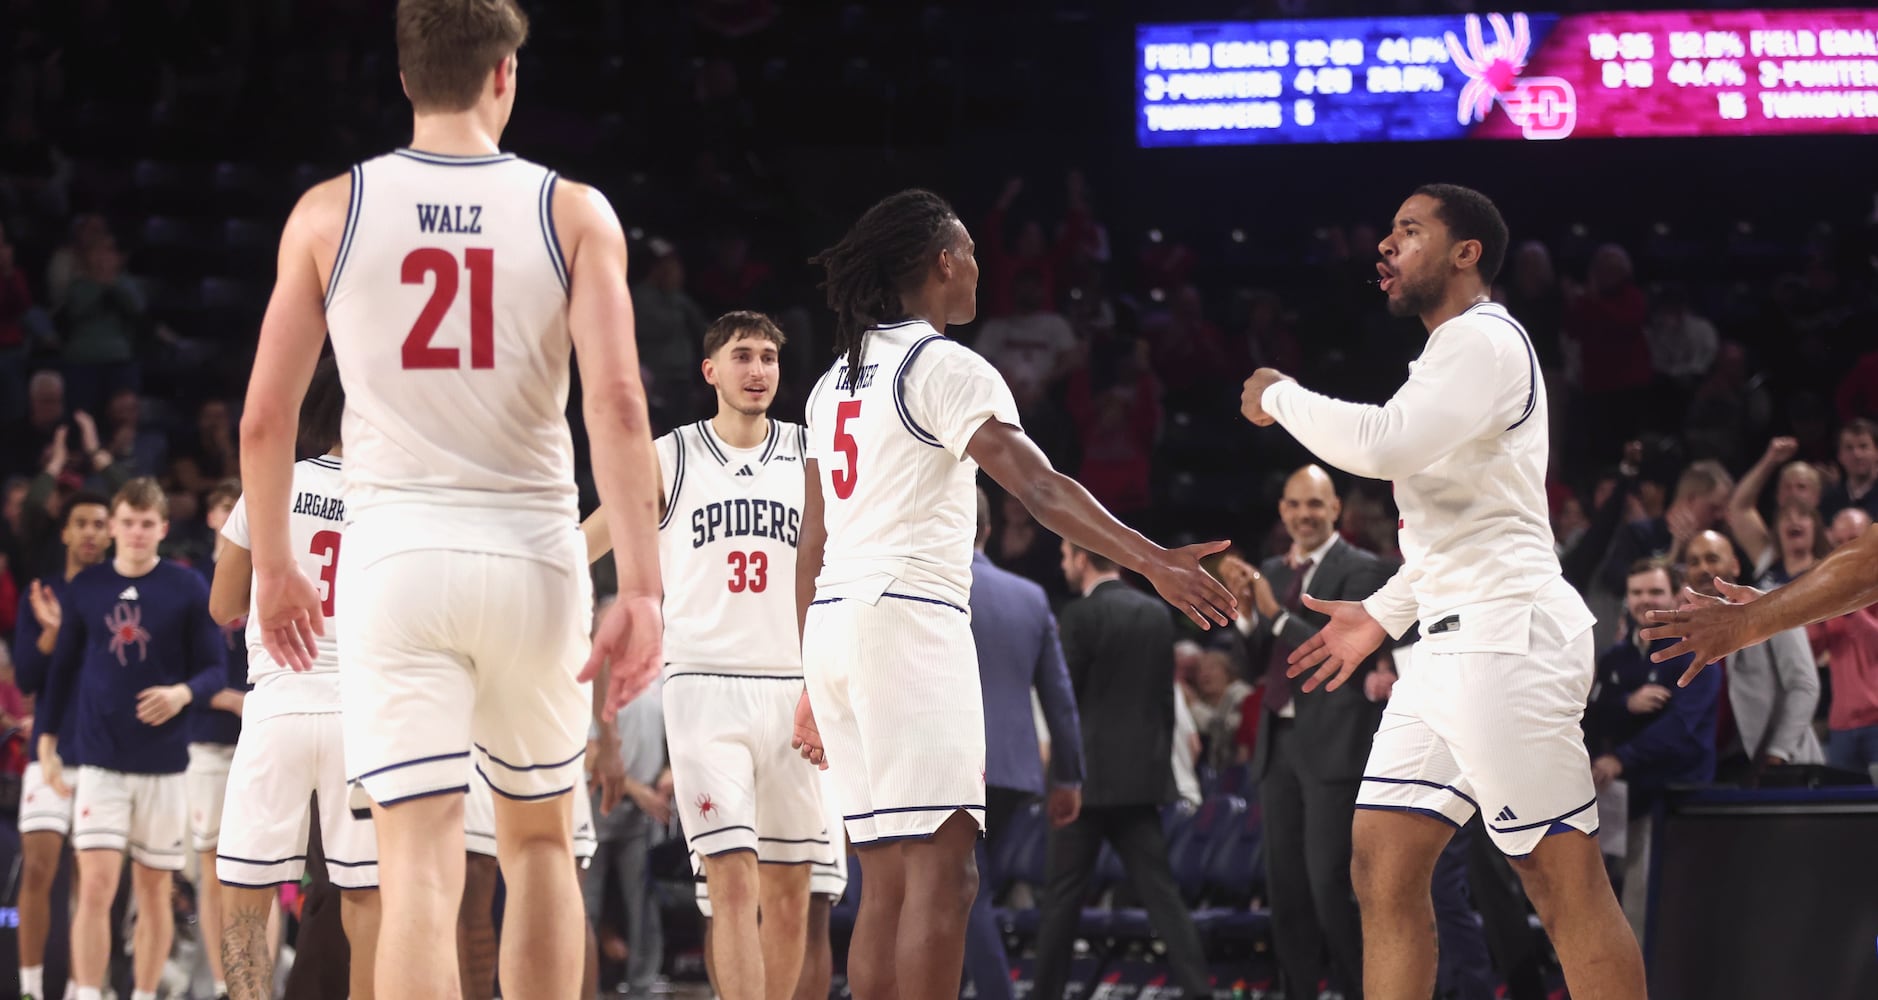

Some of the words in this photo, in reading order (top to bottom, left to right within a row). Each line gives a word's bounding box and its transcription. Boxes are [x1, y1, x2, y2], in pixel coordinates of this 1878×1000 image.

[416, 204, 482, 234] WALZ
[400, 247, 495, 370] 21
[835, 363, 879, 391] TANER
[831, 400, 862, 500] 5
[691, 498, 800, 549] SPIDERS
[727, 550, 768, 594] 33
